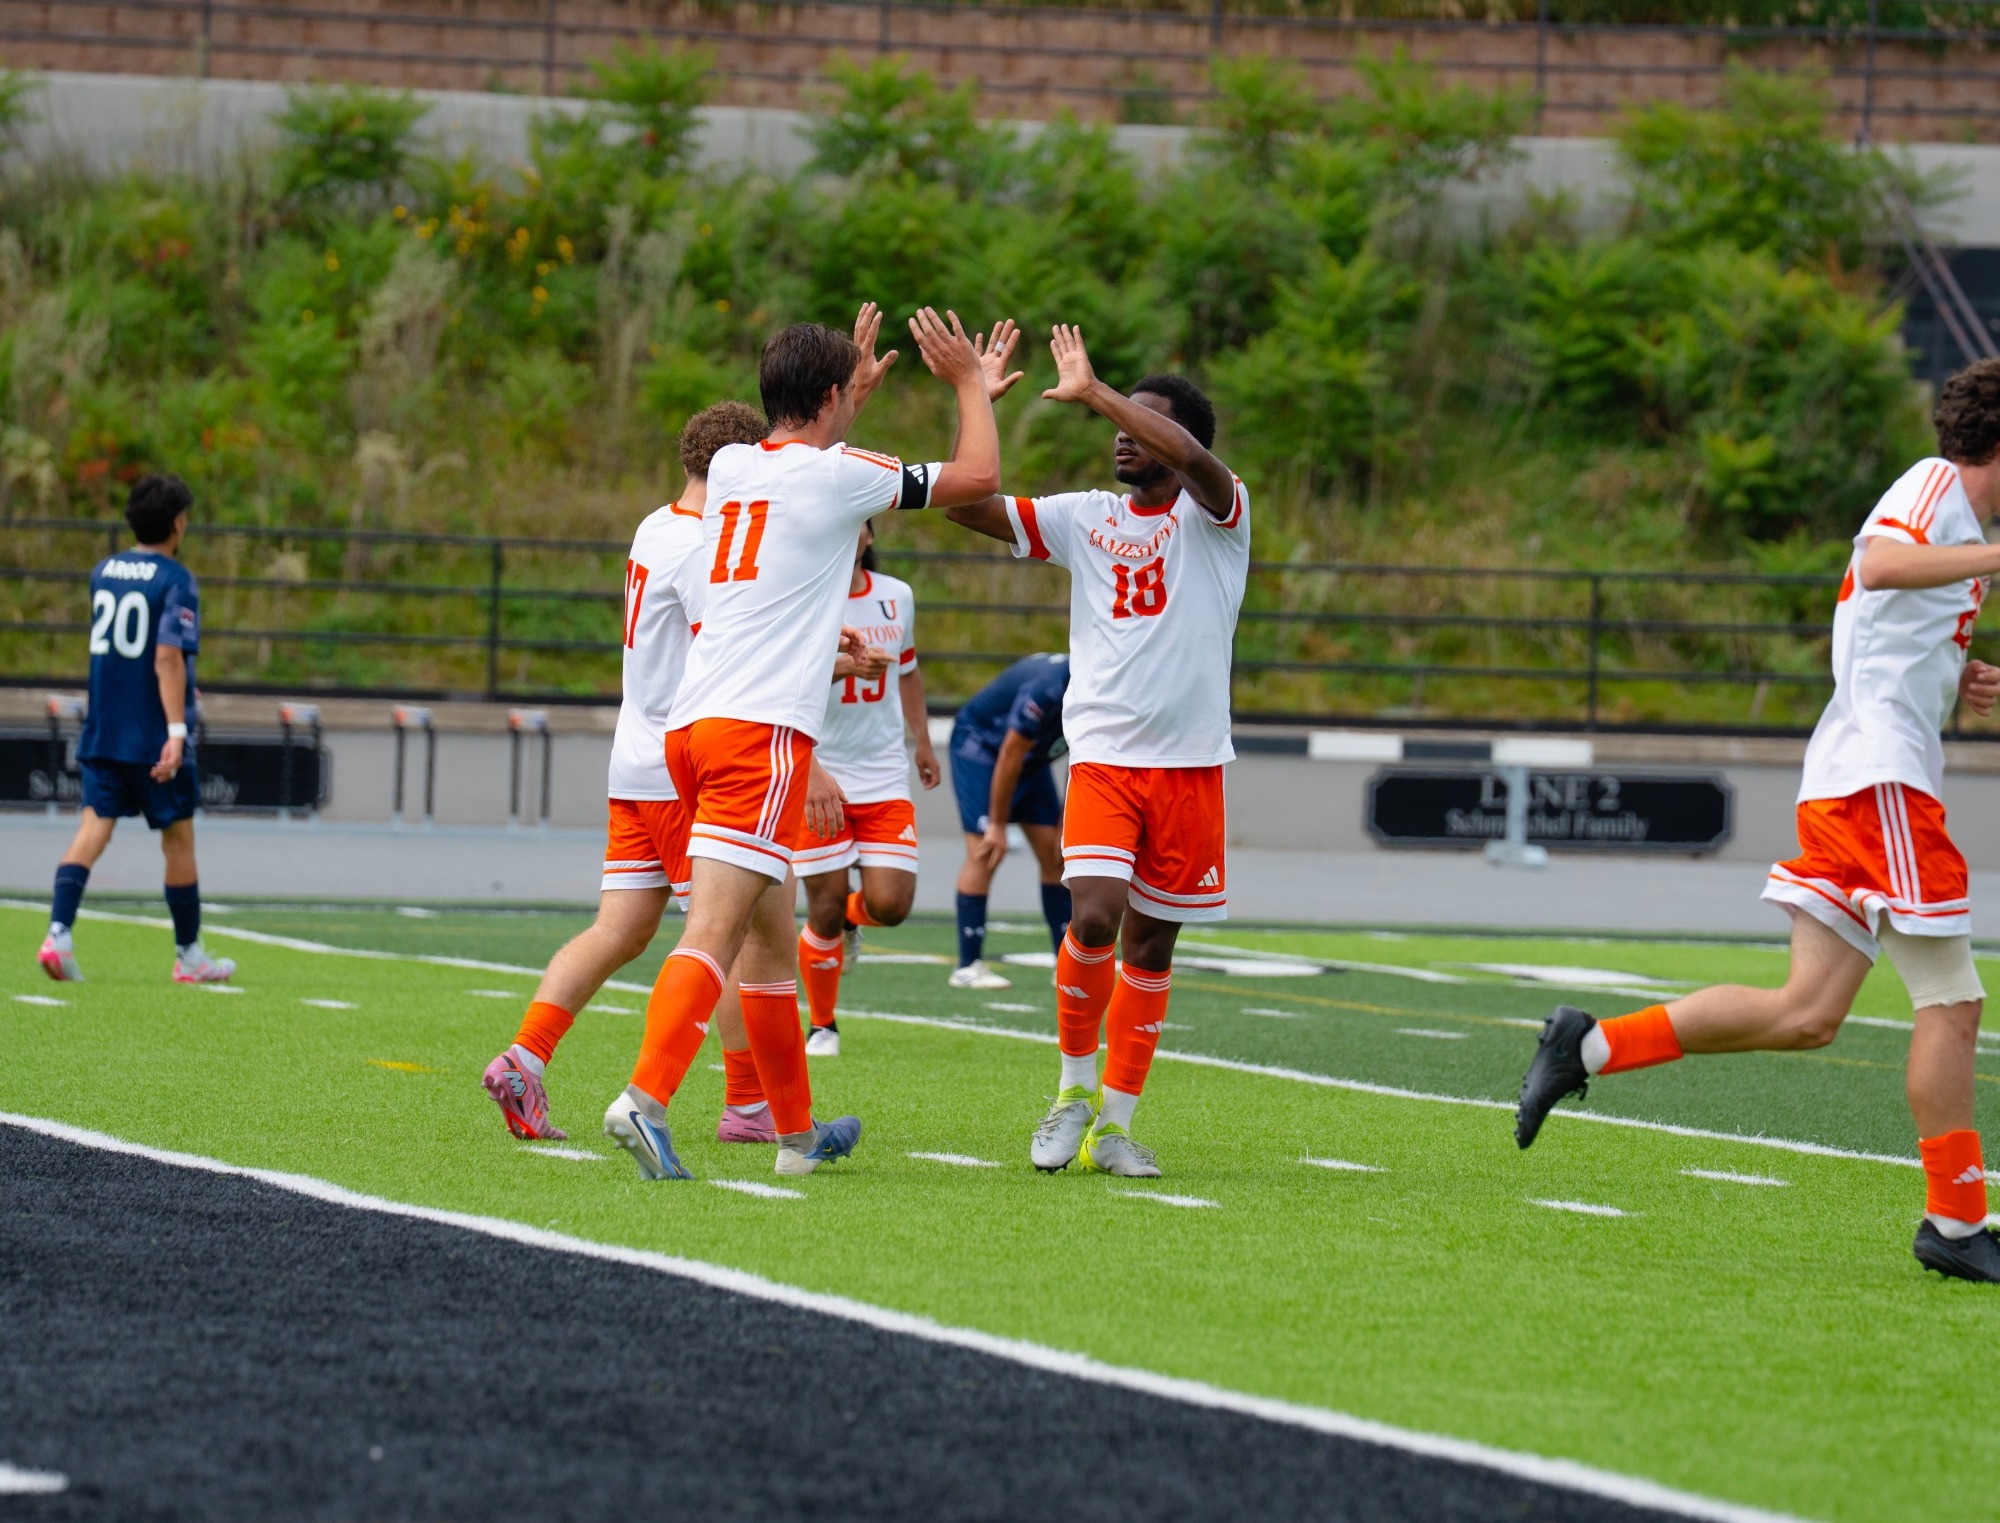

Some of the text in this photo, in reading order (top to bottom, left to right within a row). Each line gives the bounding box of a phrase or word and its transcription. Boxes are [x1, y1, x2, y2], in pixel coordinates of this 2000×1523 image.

[710, 500, 769, 583] 11
[623, 558, 650, 650] 17
[1111, 556, 1168, 620] 18
[89, 589, 150, 659] 20
[1480, 775, 1621, 811] LNE 2
